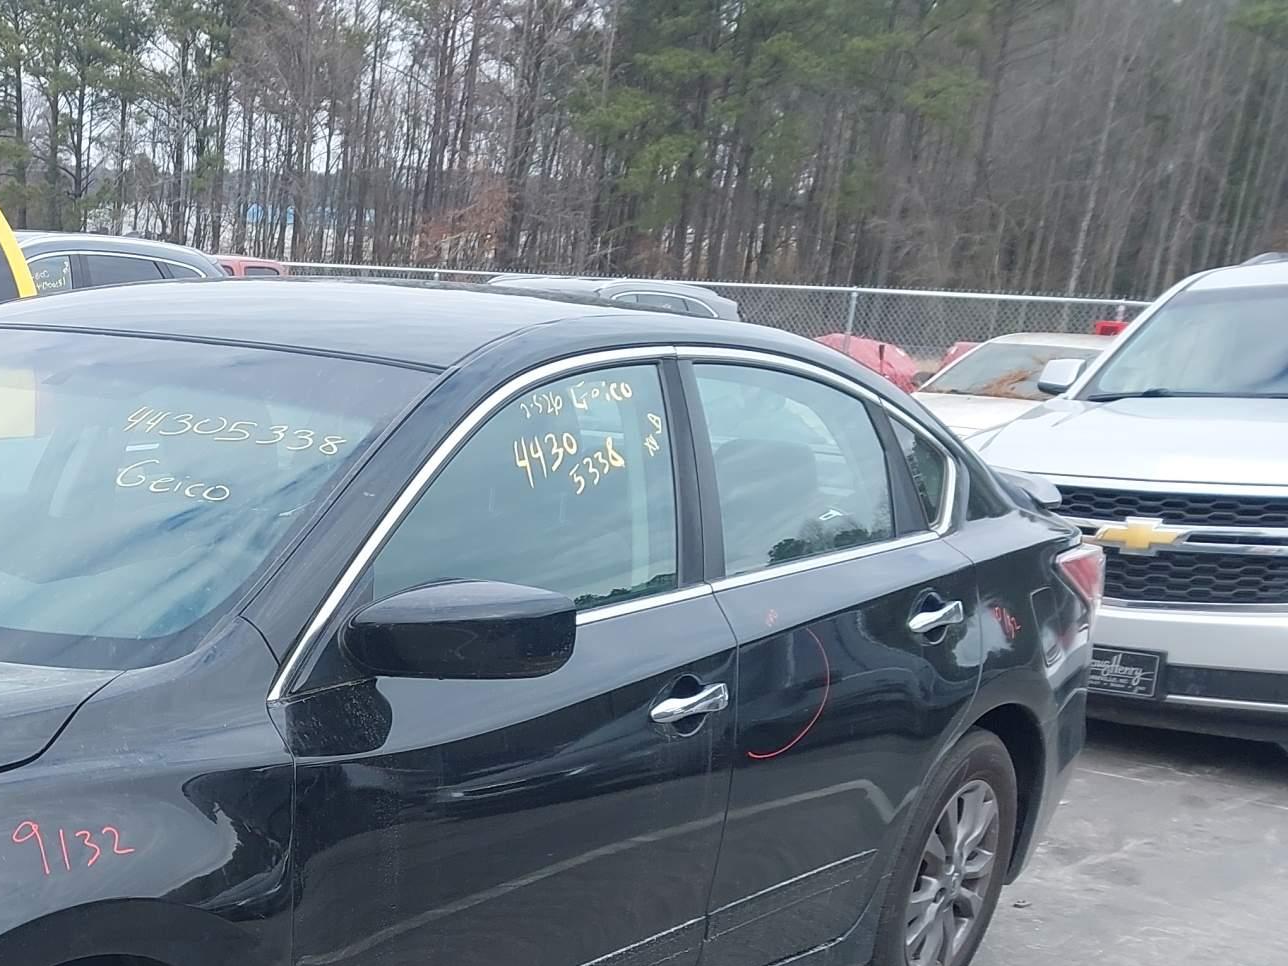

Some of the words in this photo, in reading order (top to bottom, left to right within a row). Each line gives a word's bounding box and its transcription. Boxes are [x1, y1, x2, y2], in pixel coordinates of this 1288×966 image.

[123, 406, 347, 455] 44305338
[115, 459, 230, 501] Geico
[513, 432, 577, 488] 4430
[569, 437, 626, 495] 5338
[12, 820, 135, 875] 9132
